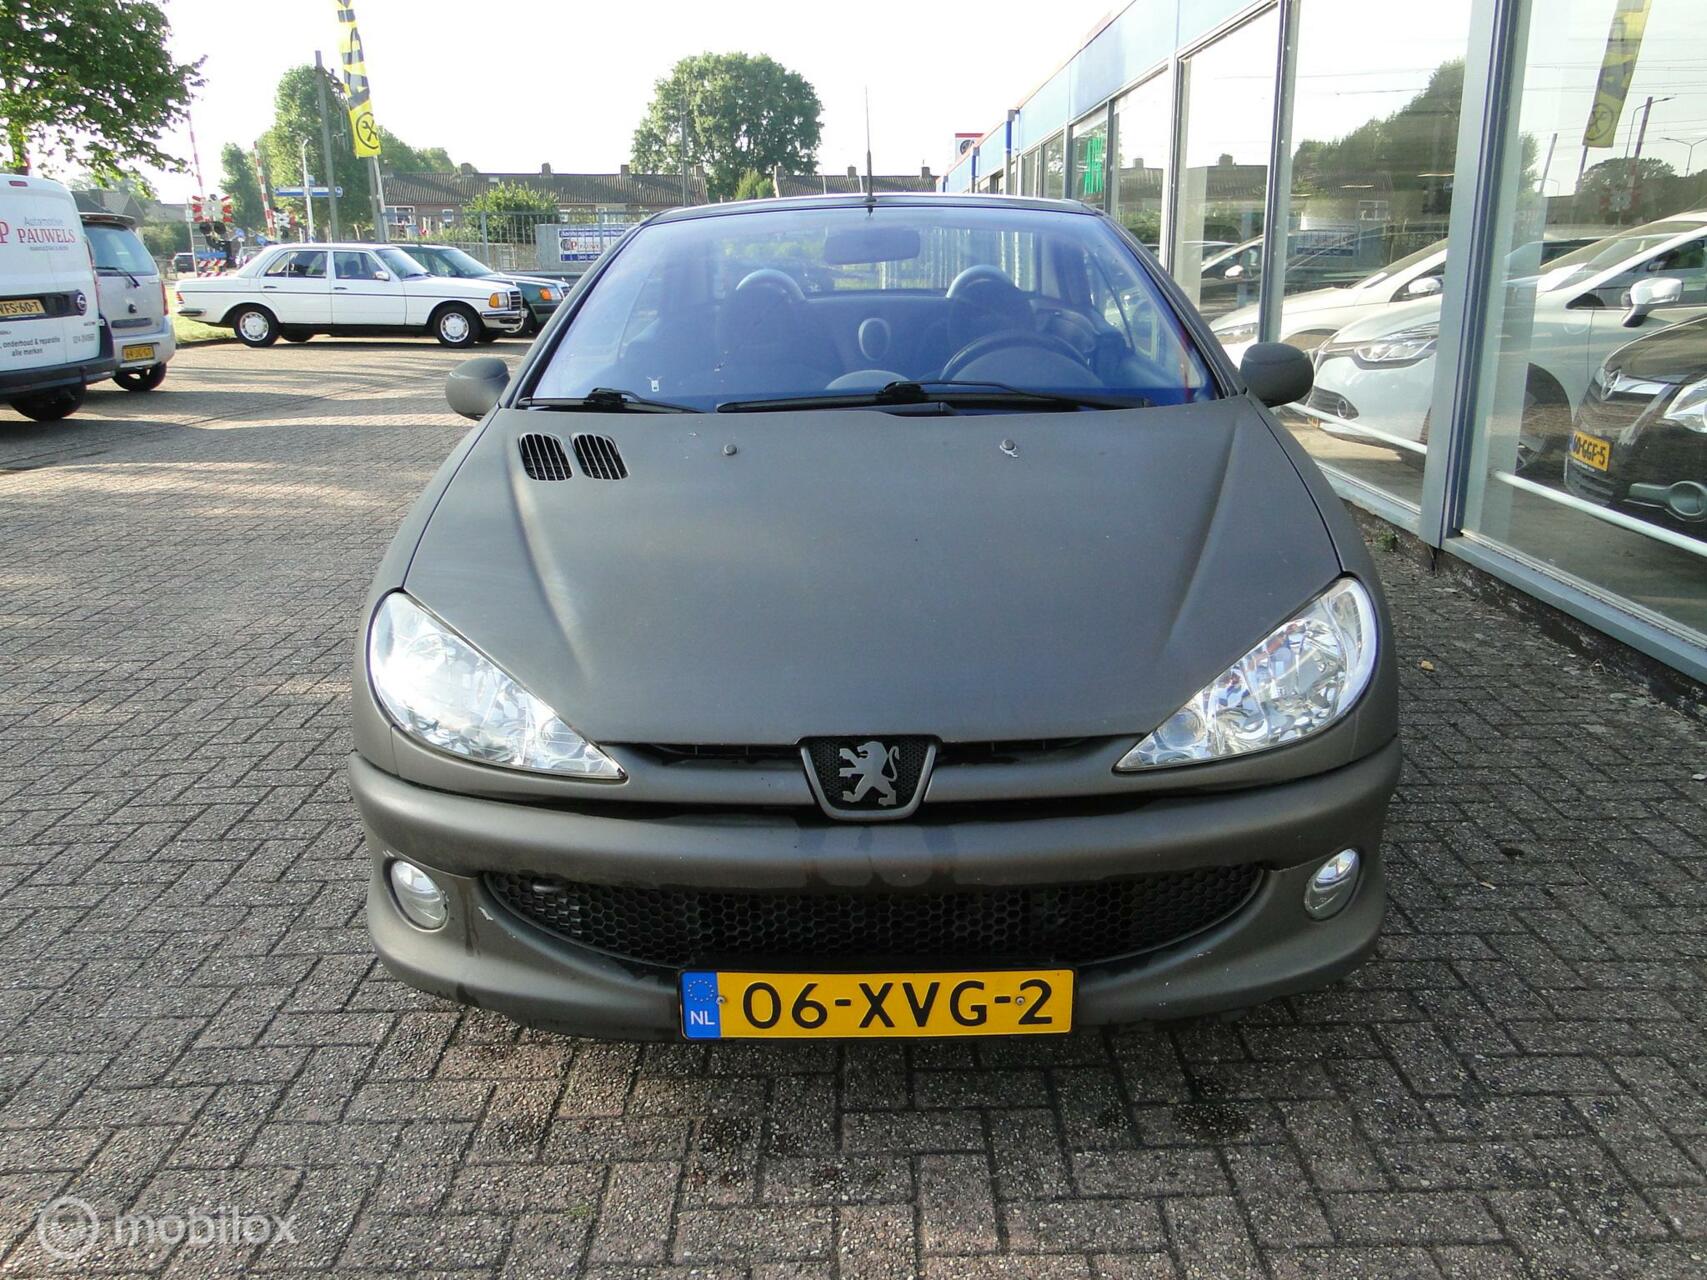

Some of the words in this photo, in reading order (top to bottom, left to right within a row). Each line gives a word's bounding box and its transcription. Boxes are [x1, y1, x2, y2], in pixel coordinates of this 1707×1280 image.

[17, 228, 76, 244] PAUWELS
[11, 349, 22, 357] alle
[741, 978, 1054, 1030] 06-XVG-2
[690, 1009, 715, 1026] NL
